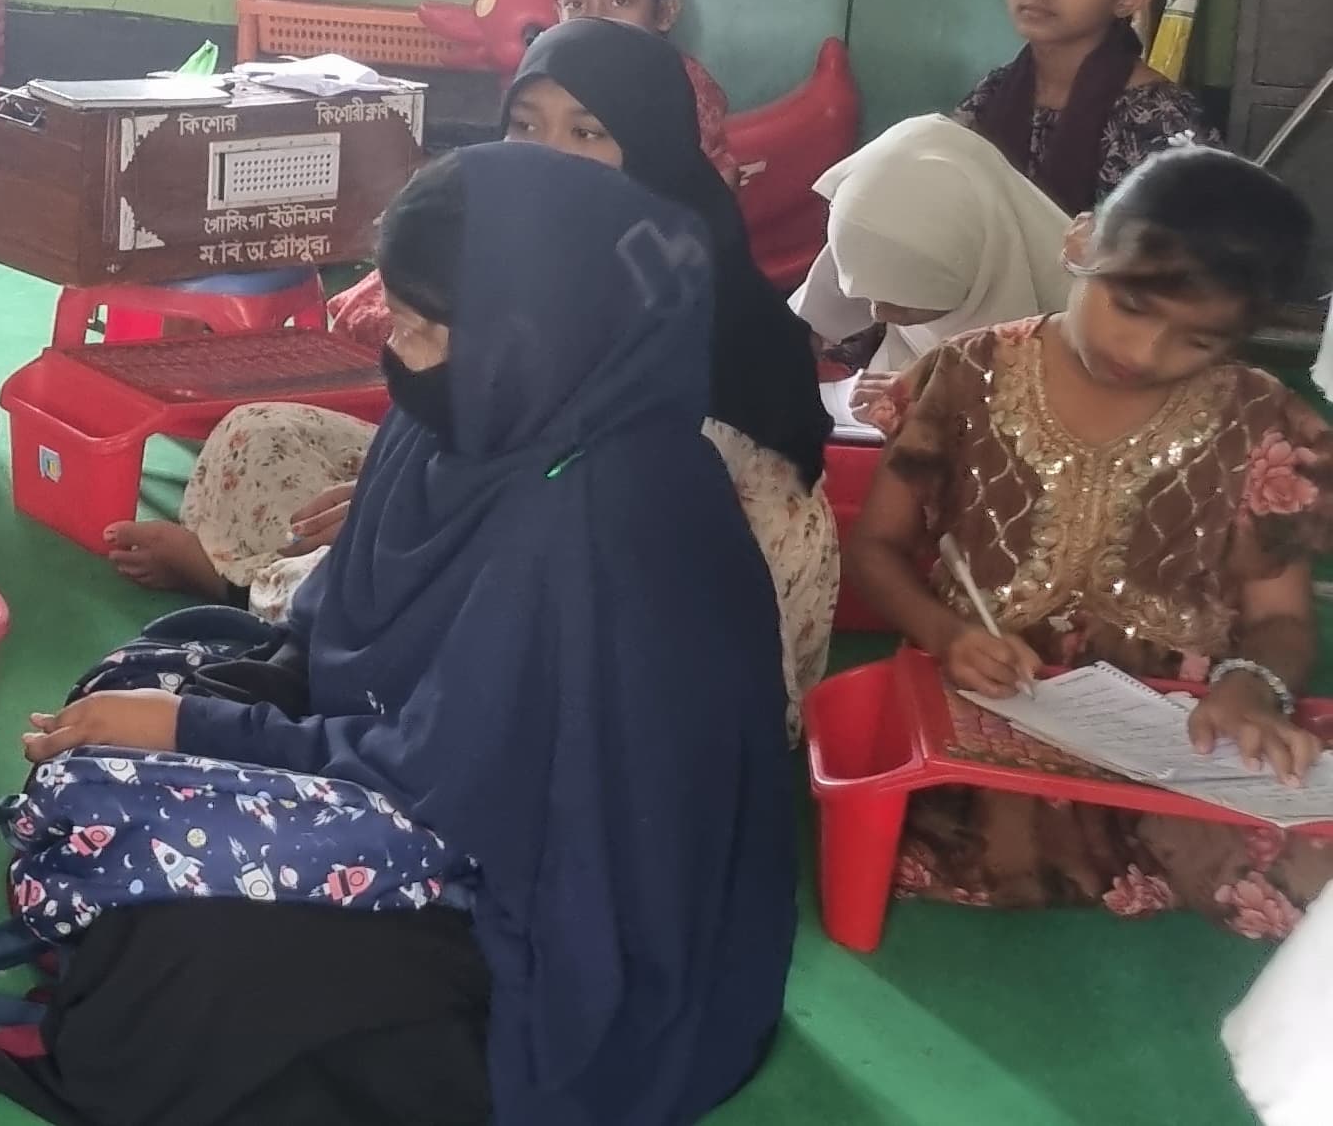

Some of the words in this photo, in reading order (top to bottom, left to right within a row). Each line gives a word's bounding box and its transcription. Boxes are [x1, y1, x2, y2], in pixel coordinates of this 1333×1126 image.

[178, 113, 239, 136] কিশোর
[203, 210, 267, 235] গোসিংগা
[268, 204, 338, 229] ইউনিয়ন
